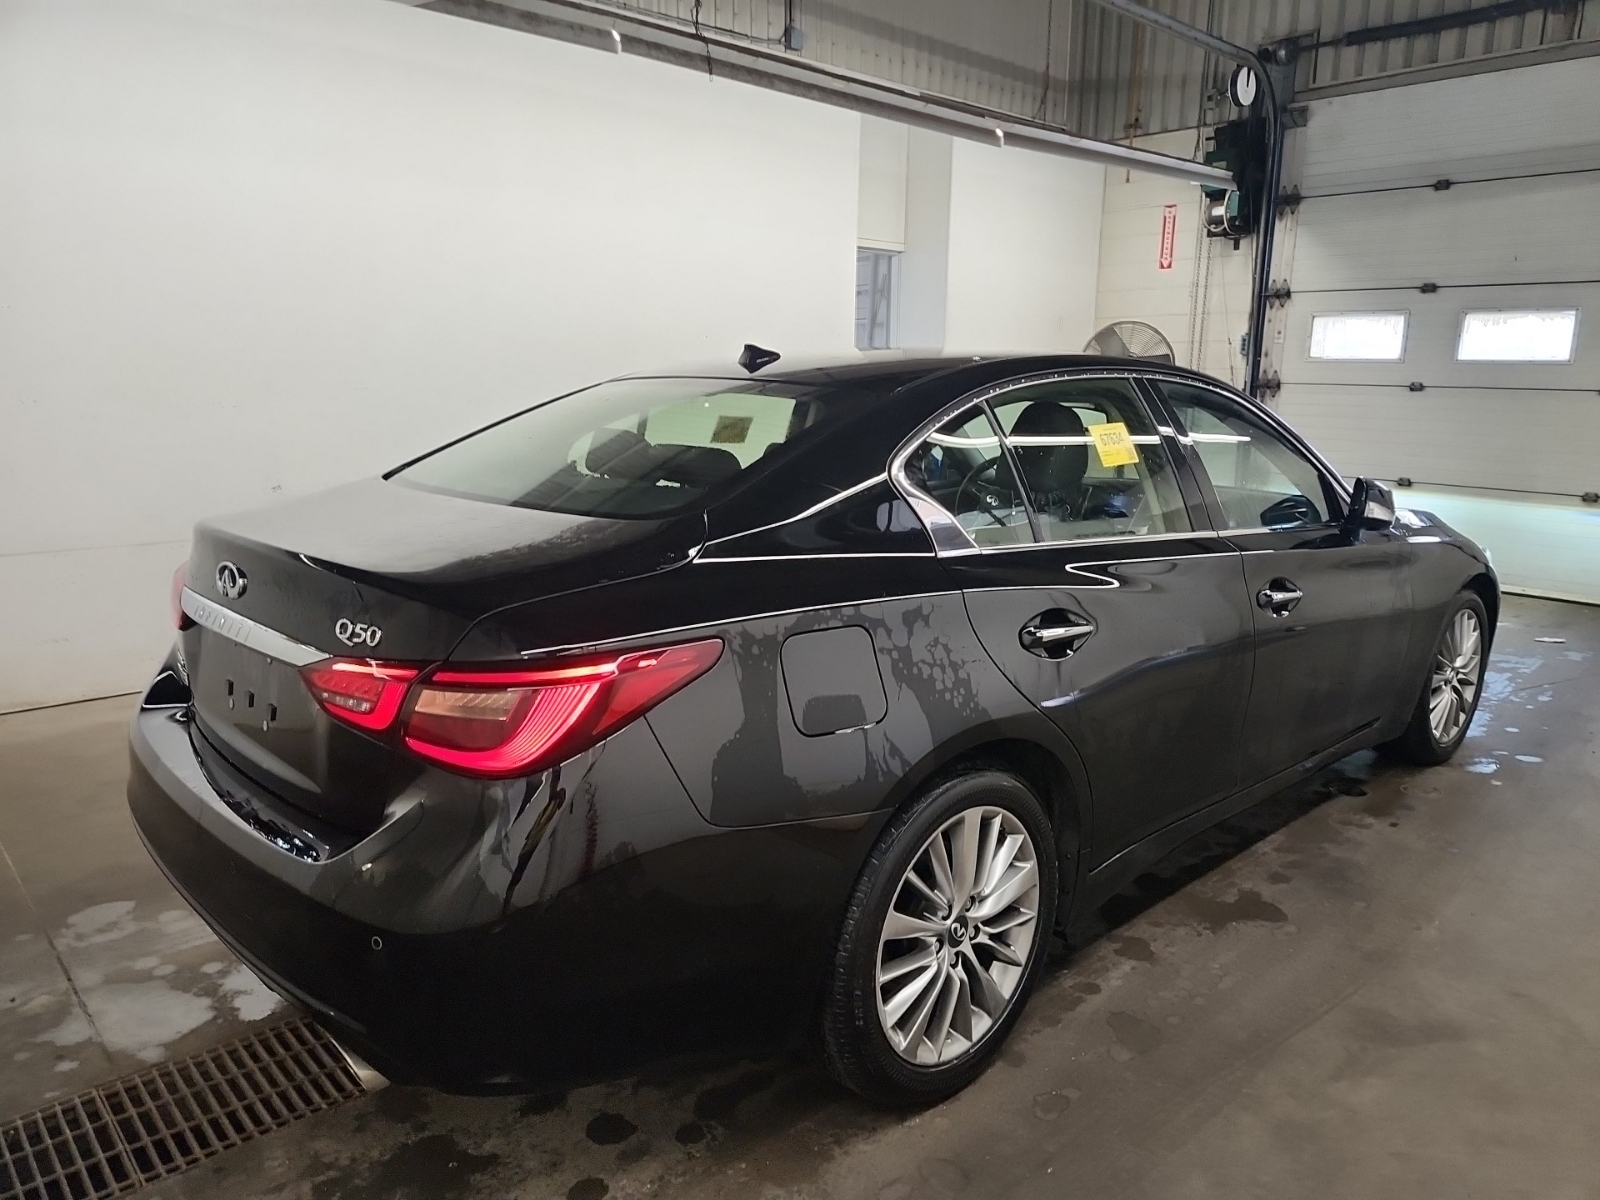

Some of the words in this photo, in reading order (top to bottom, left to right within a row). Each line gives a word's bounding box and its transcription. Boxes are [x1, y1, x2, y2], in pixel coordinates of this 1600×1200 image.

[1099, 432, 1124, 446] 67634
[194, 604, 252, 642] INFINITI
[335, 617, 382, 647] Q50
